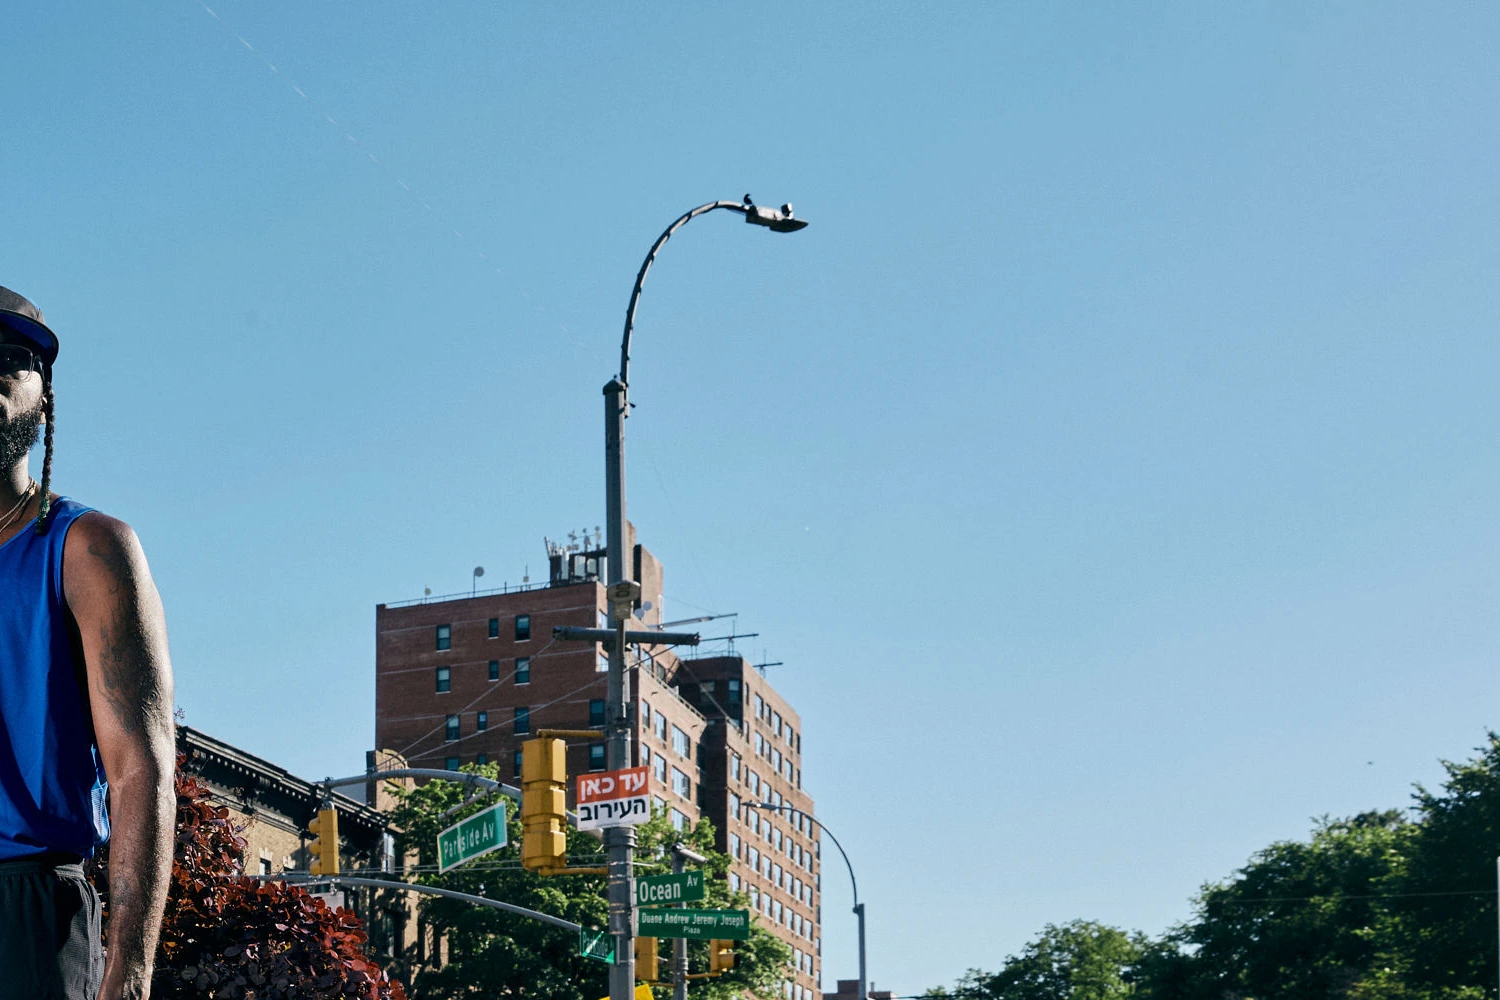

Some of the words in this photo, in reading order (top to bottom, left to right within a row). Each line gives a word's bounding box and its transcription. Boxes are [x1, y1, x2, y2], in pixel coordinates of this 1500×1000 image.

[580, 776, 615, 801] כאן
[618, 771, 646, 792] עד
[580, 798, 646, 822] העירוב
[482, 821, 495, 843] Av
[639, 881, 681, 902] Ocean
[686, 874, 699, 888] Av
[641, 912, 663, 924] Duane
[664, 912, 690, 924] Andrew
[691, 913, 718, 928] Jeremy
[720, 914, 745, 928] Joseph
[683, 926, 701, 935] Plaza
